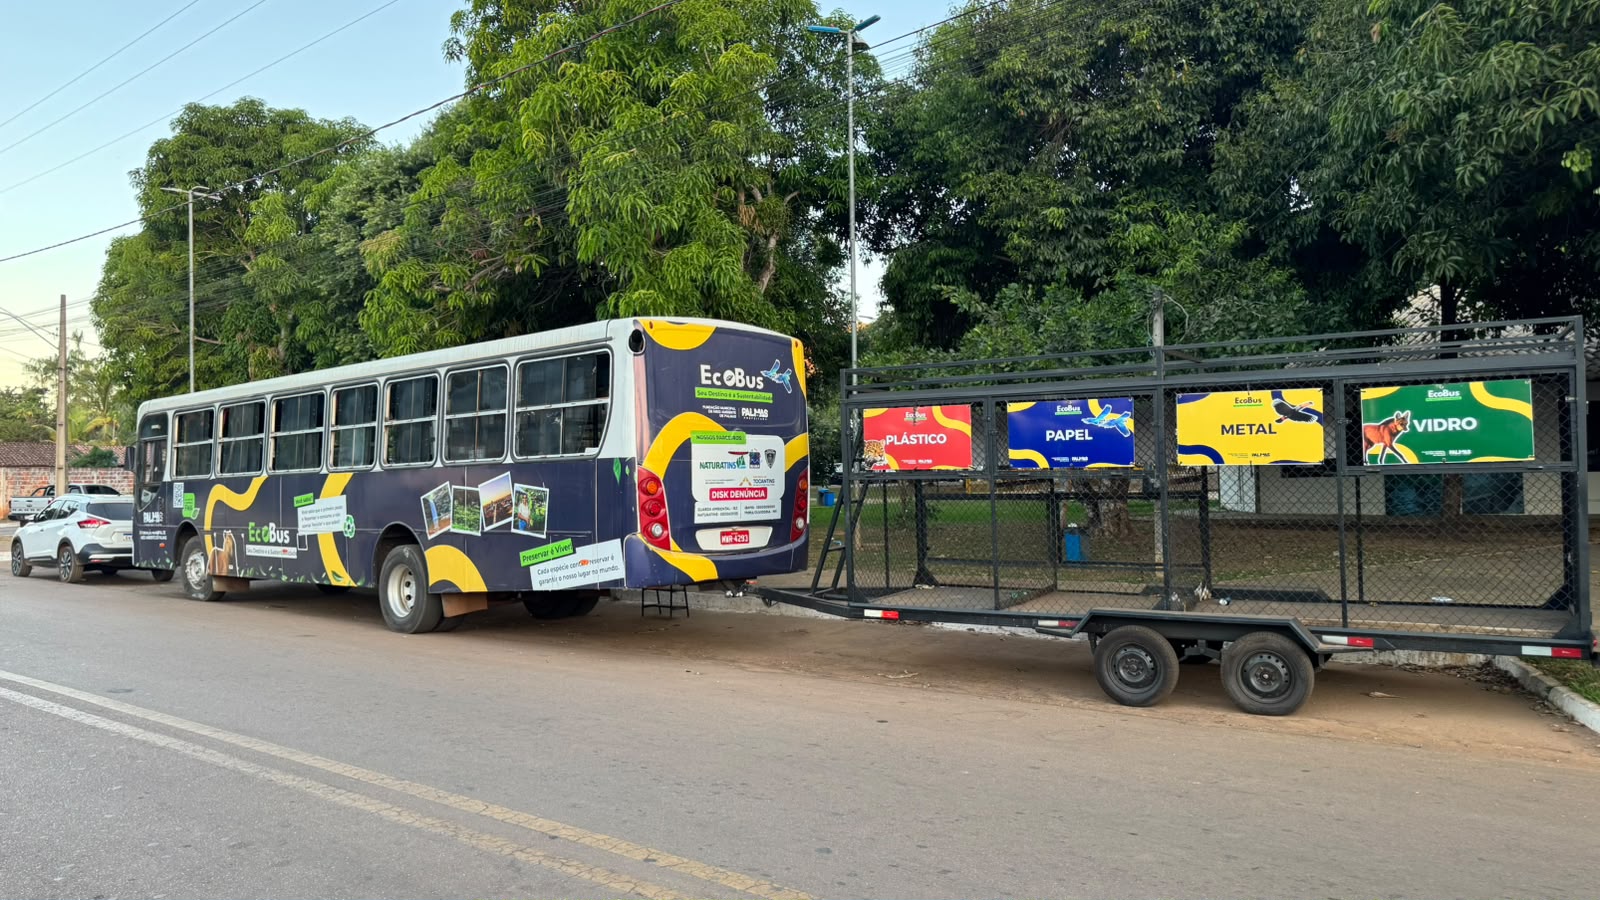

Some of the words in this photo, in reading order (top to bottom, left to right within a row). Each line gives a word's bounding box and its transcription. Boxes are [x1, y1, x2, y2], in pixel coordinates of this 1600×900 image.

[700, 364, 764, 389] EcoBus
[708, 390, 728, 398] Destino
[1427, 389, 1460, 398] EcoBus
[741, 407, 769, 418] PALMAS
[1056, 404, 1081, 412] EcoBus
[1221, 423, 1277, 435] METAL
[1412, 417, 1477, 433] VIDRO
[886, 432, 947, 445] PLÁSTICO
[1046, 429, 1093, 441] PAPEL
[699, 461, 737, 470] NATURATINS
[711, 490, 729, 499] DISK
[730, 488, 765, 499] DENÚNCIA
[248, 521, 290, 544] EcoBus
[523, 551, 549, 562] Preservar
[551, 547, 554, 555] é
[537, 566, 549, 575] Cada
[550, 562, 570, 573] espécie
[611, 552, 615, 561] é
[538, 575, 558, 587] garantir
[563, 572, 577, 580] nosso
[578, 570, 591, 579] lugar
[599, 563, 620, 574] mundo.
